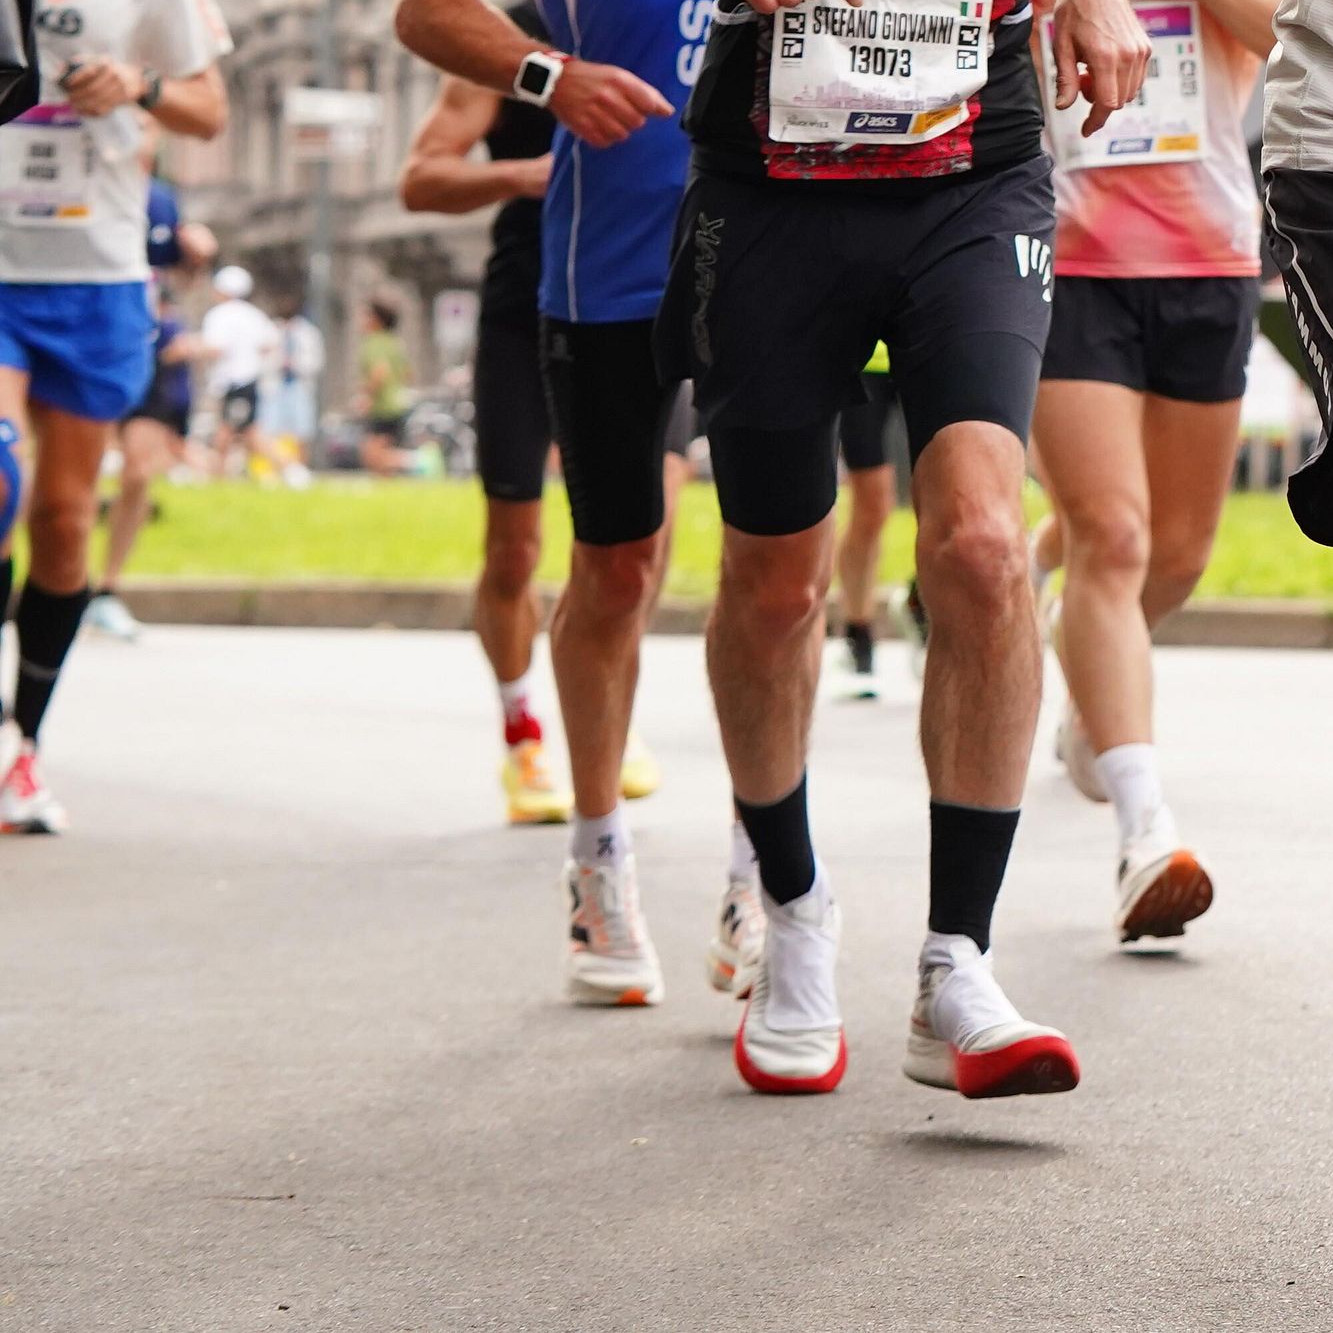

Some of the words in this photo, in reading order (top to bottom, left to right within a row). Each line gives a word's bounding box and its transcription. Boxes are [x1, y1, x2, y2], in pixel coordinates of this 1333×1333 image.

[812, 6, 878, 40] STEFANO
[882, 11, 954, 45] GIOVANNI
[850, 45, 912, 77] 13073
[867, 116, 898, 127] asics
